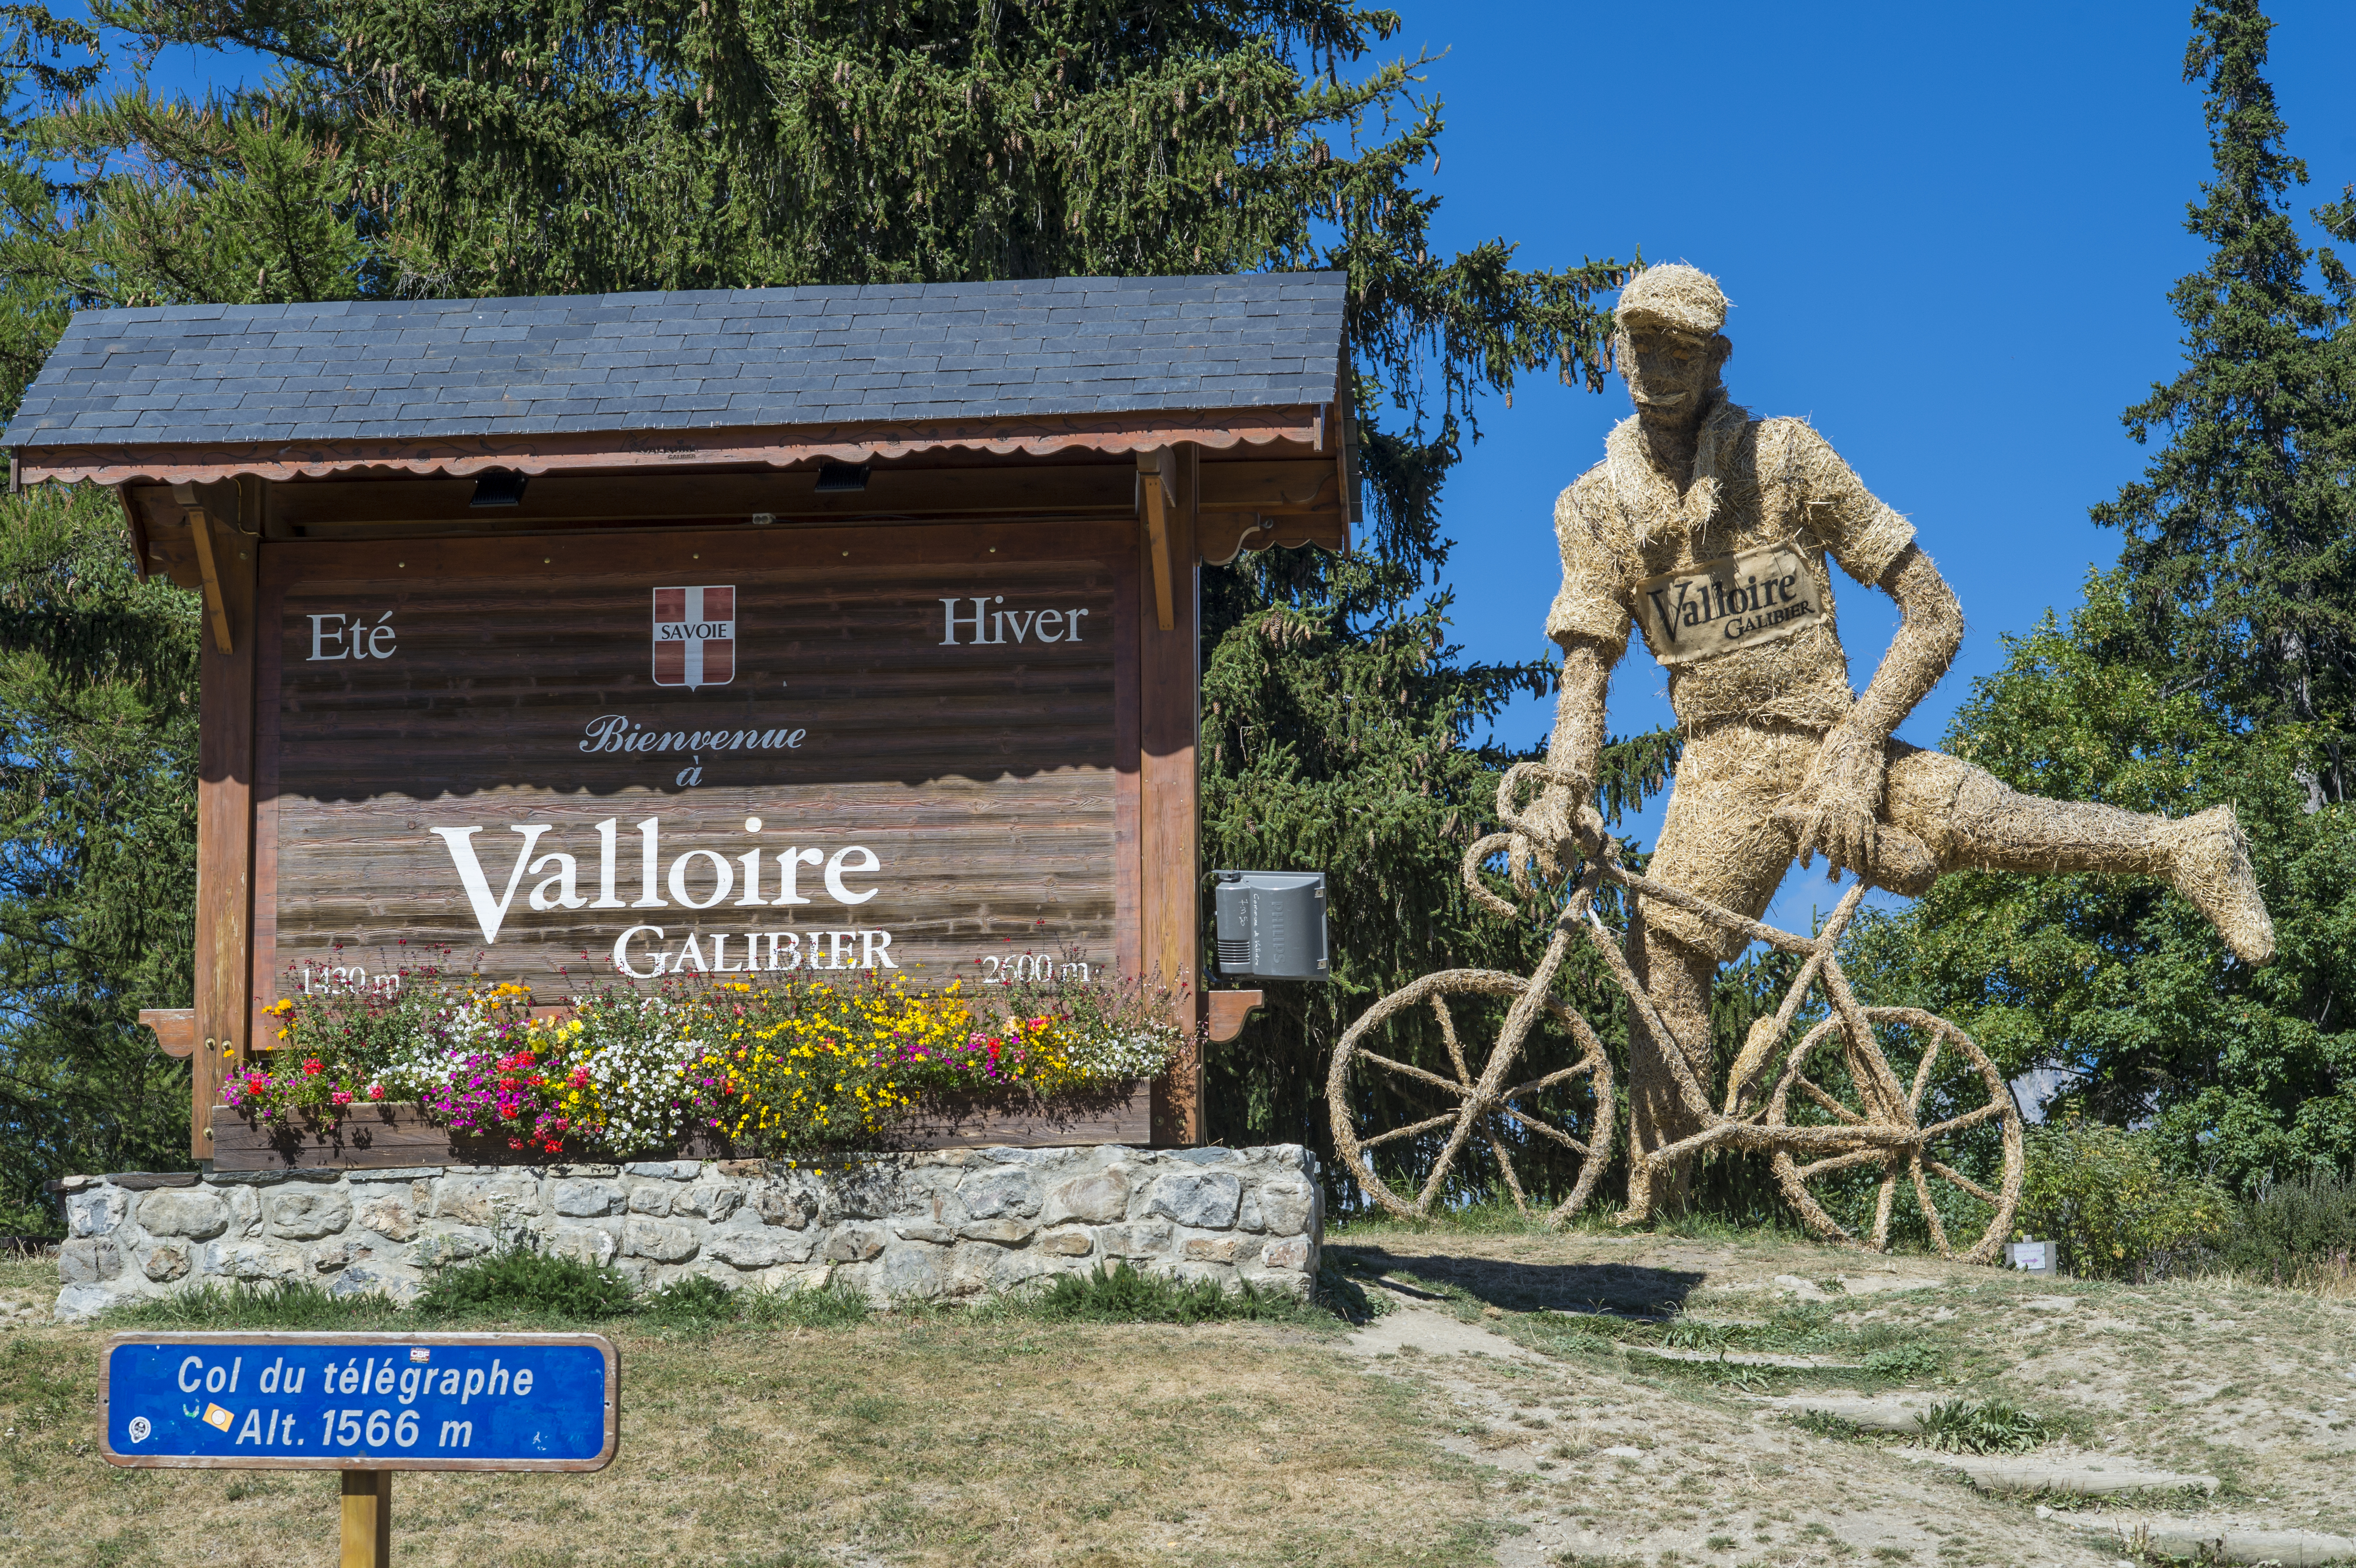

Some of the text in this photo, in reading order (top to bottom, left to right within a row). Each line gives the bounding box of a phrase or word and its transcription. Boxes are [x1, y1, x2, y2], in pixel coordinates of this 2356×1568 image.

[939, 596, 1089, 645] Hiver
[1646, 575, 1797, 642] Valloire
[1724, 600, 1815, 639] GALIBIER
[306, 610, 397, 660] Eté
[662, 624, 726, 640] SAVOIE
[579, 715, 806, 752] Bienvenue
[676, 755, 702, 786] à
[430, 816, 881, 945] Valloire
[613, 926, 899, 979] GALIBIER
[1272, 901, 1286, 963] PHILIPS
[373, 974, 400, 994] m
[1060, 962, 1090, 982] m
[178, 1356, 533, 1405] Col du télégraphe
[236, 1409, 304, 1445] Alt.
[323, 1409, 420, 1448] 1566
[439, 1420, 472, 1447] m
